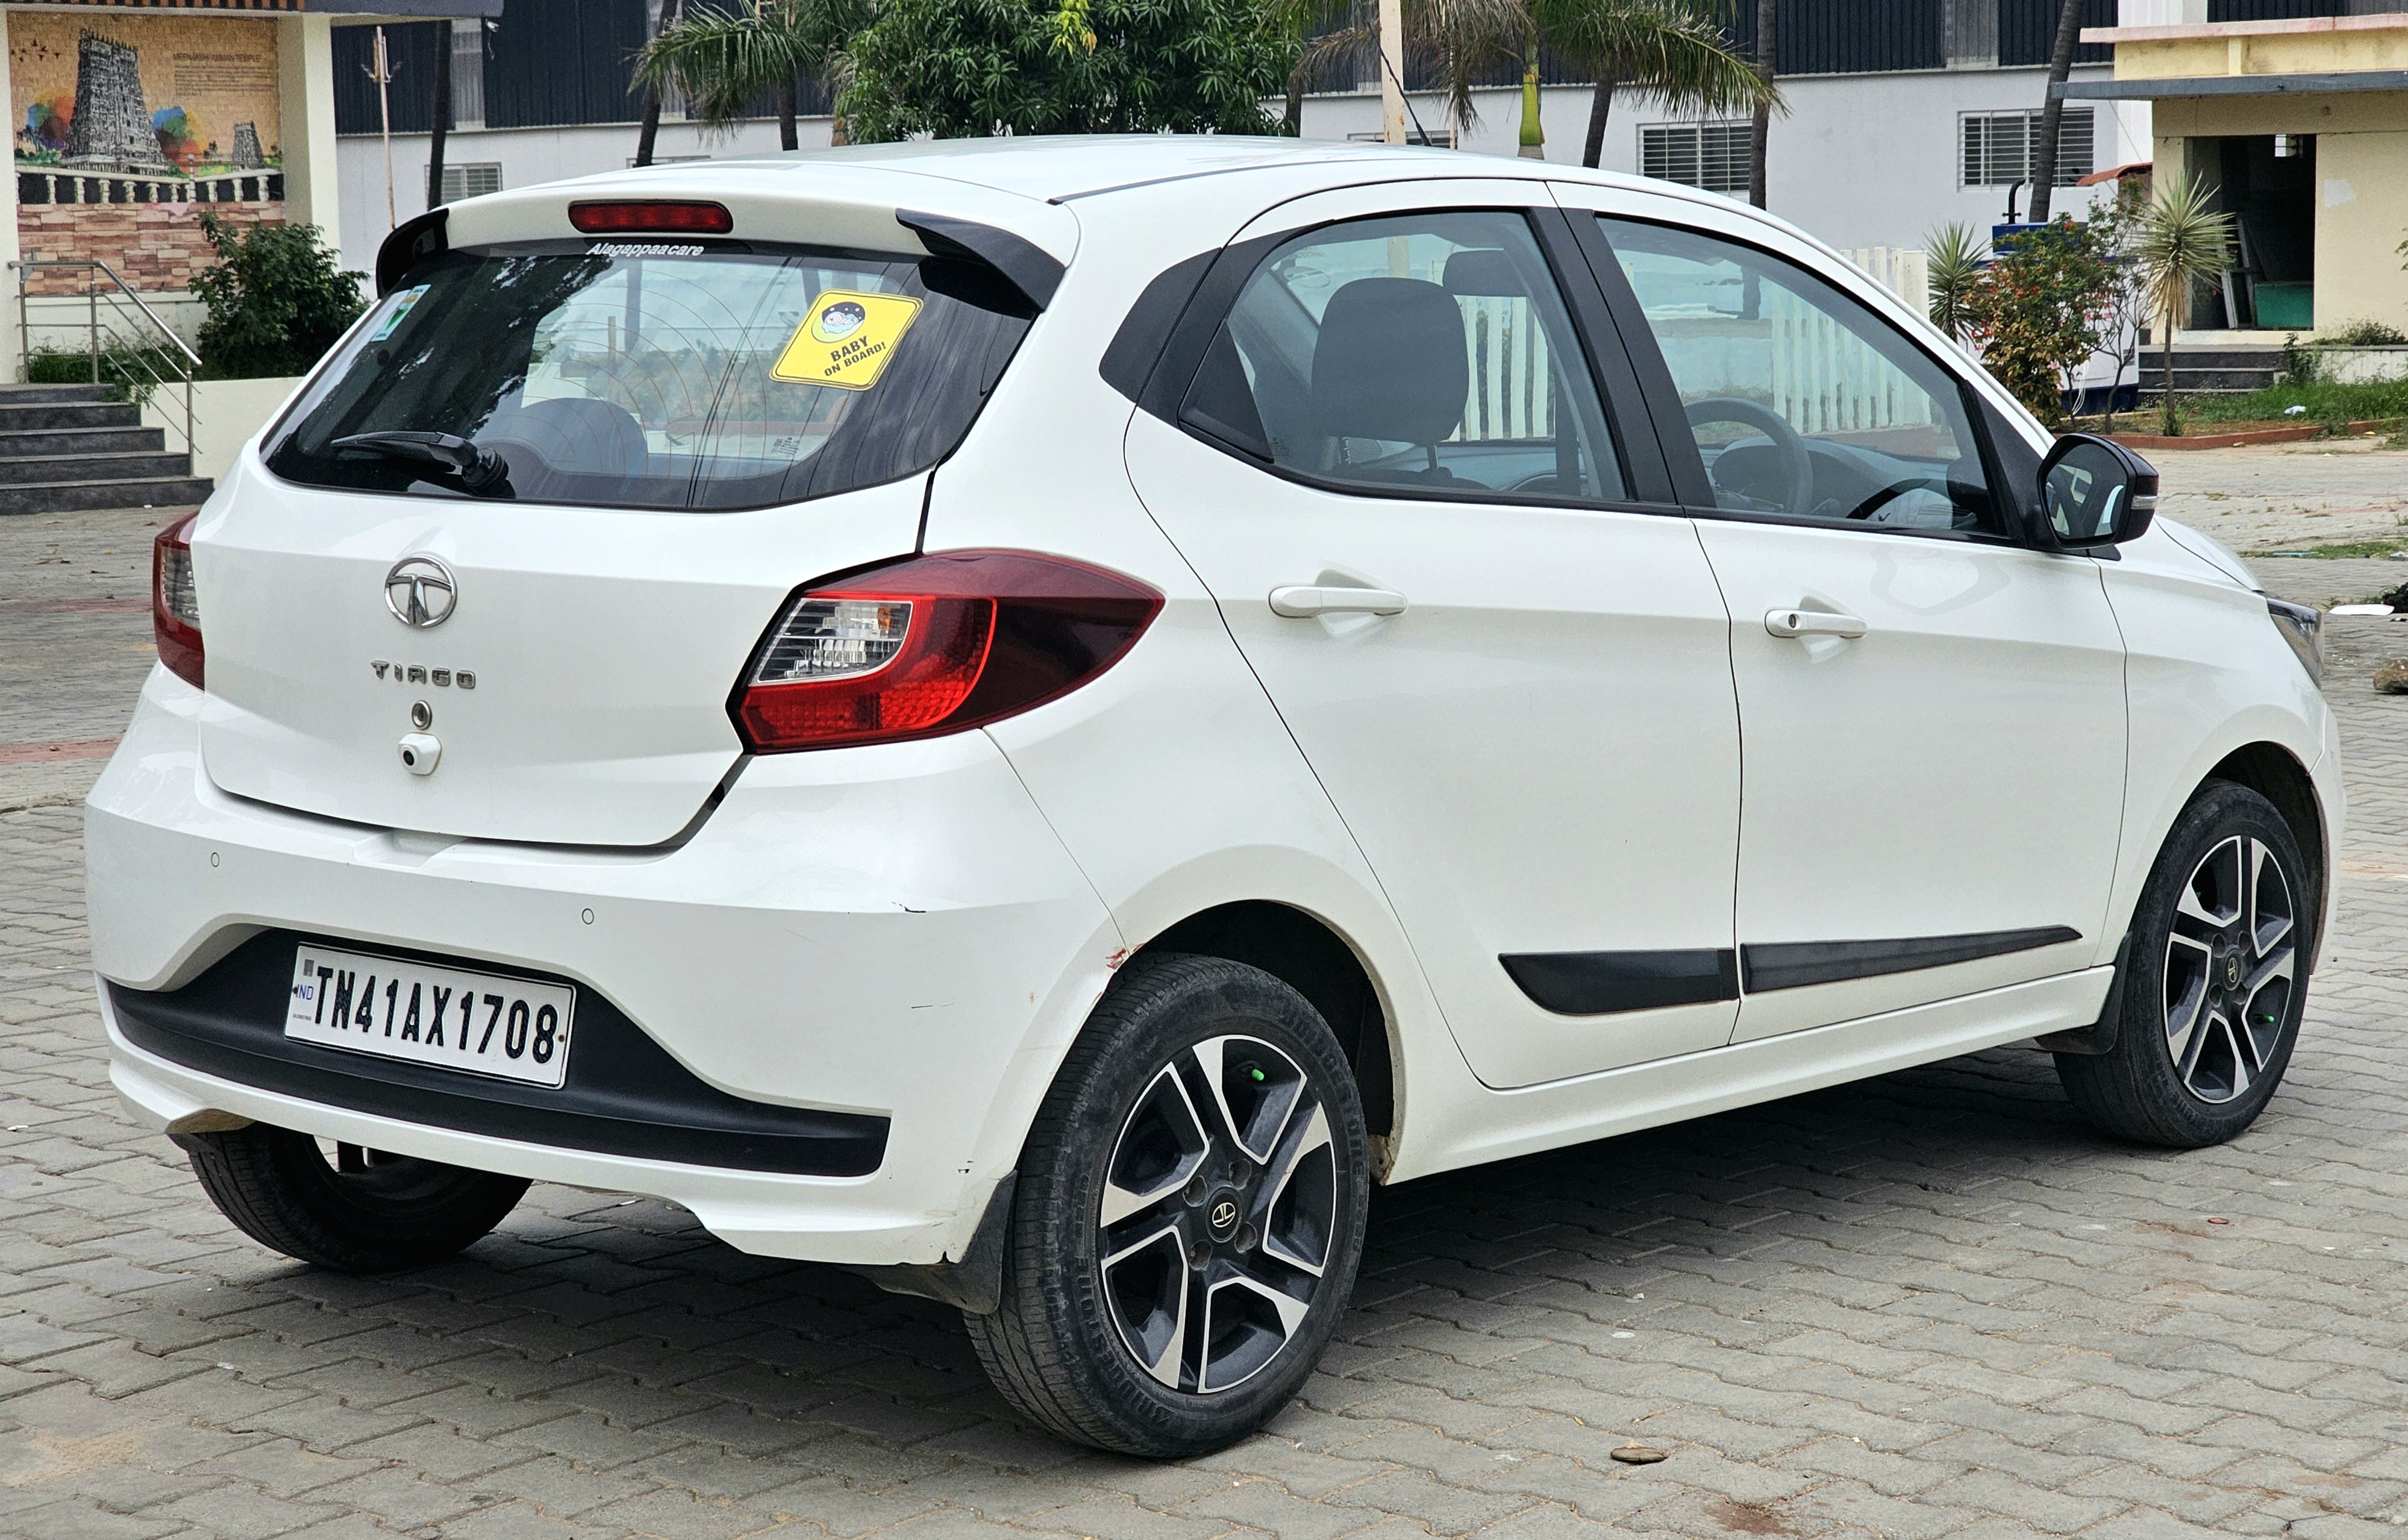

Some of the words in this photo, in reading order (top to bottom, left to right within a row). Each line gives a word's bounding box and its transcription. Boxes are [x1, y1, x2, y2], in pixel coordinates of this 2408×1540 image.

[586, 243, 704, 257] Alagappaacare
[824, 363, 841, 377] ON
[843, 342, 887, 367] BOARD!
[830, 336, 869, 362] BABY
[371, 660, 476, 689] TIAGO
[296, 983, 314, 1000] IND
[314, 966, 558, 1064] TN41AX1708
